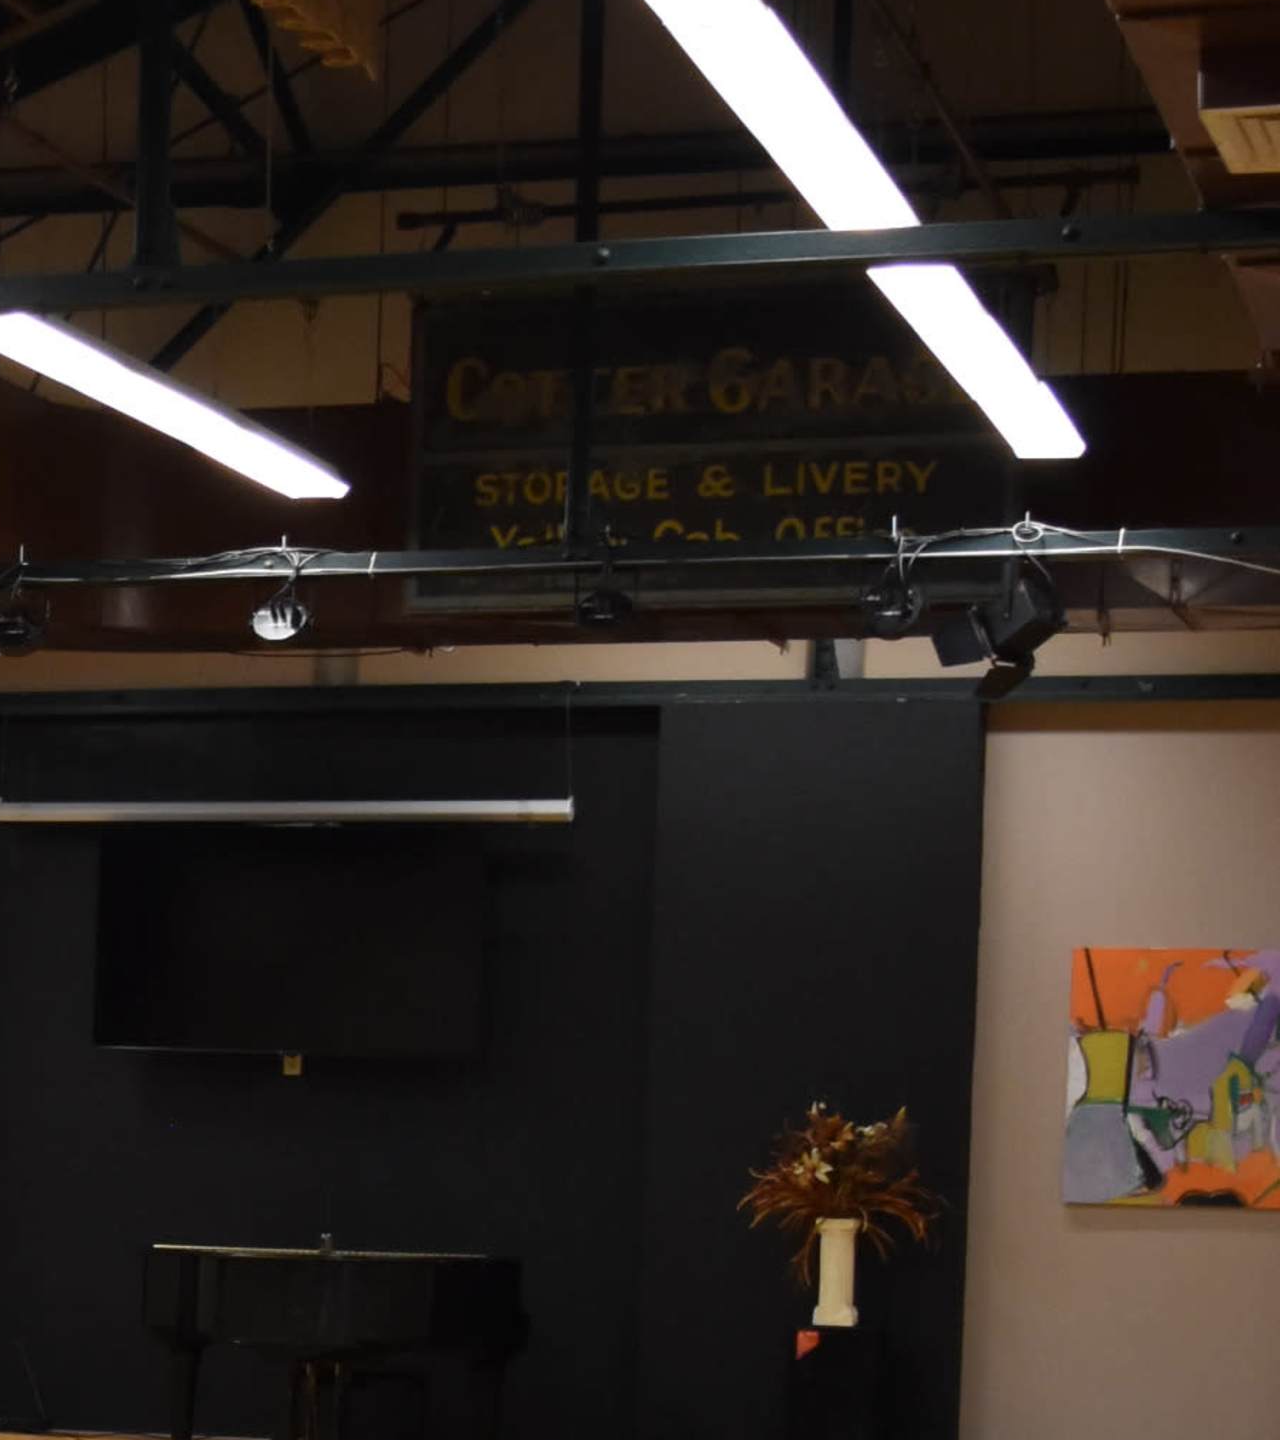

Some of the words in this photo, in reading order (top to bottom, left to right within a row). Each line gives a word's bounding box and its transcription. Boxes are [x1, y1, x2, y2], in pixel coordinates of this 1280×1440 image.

[708, 345, 976, 414] GARAG
[697, 464, 736, 497] &
[763, 461, 937, 496] LIVERY
